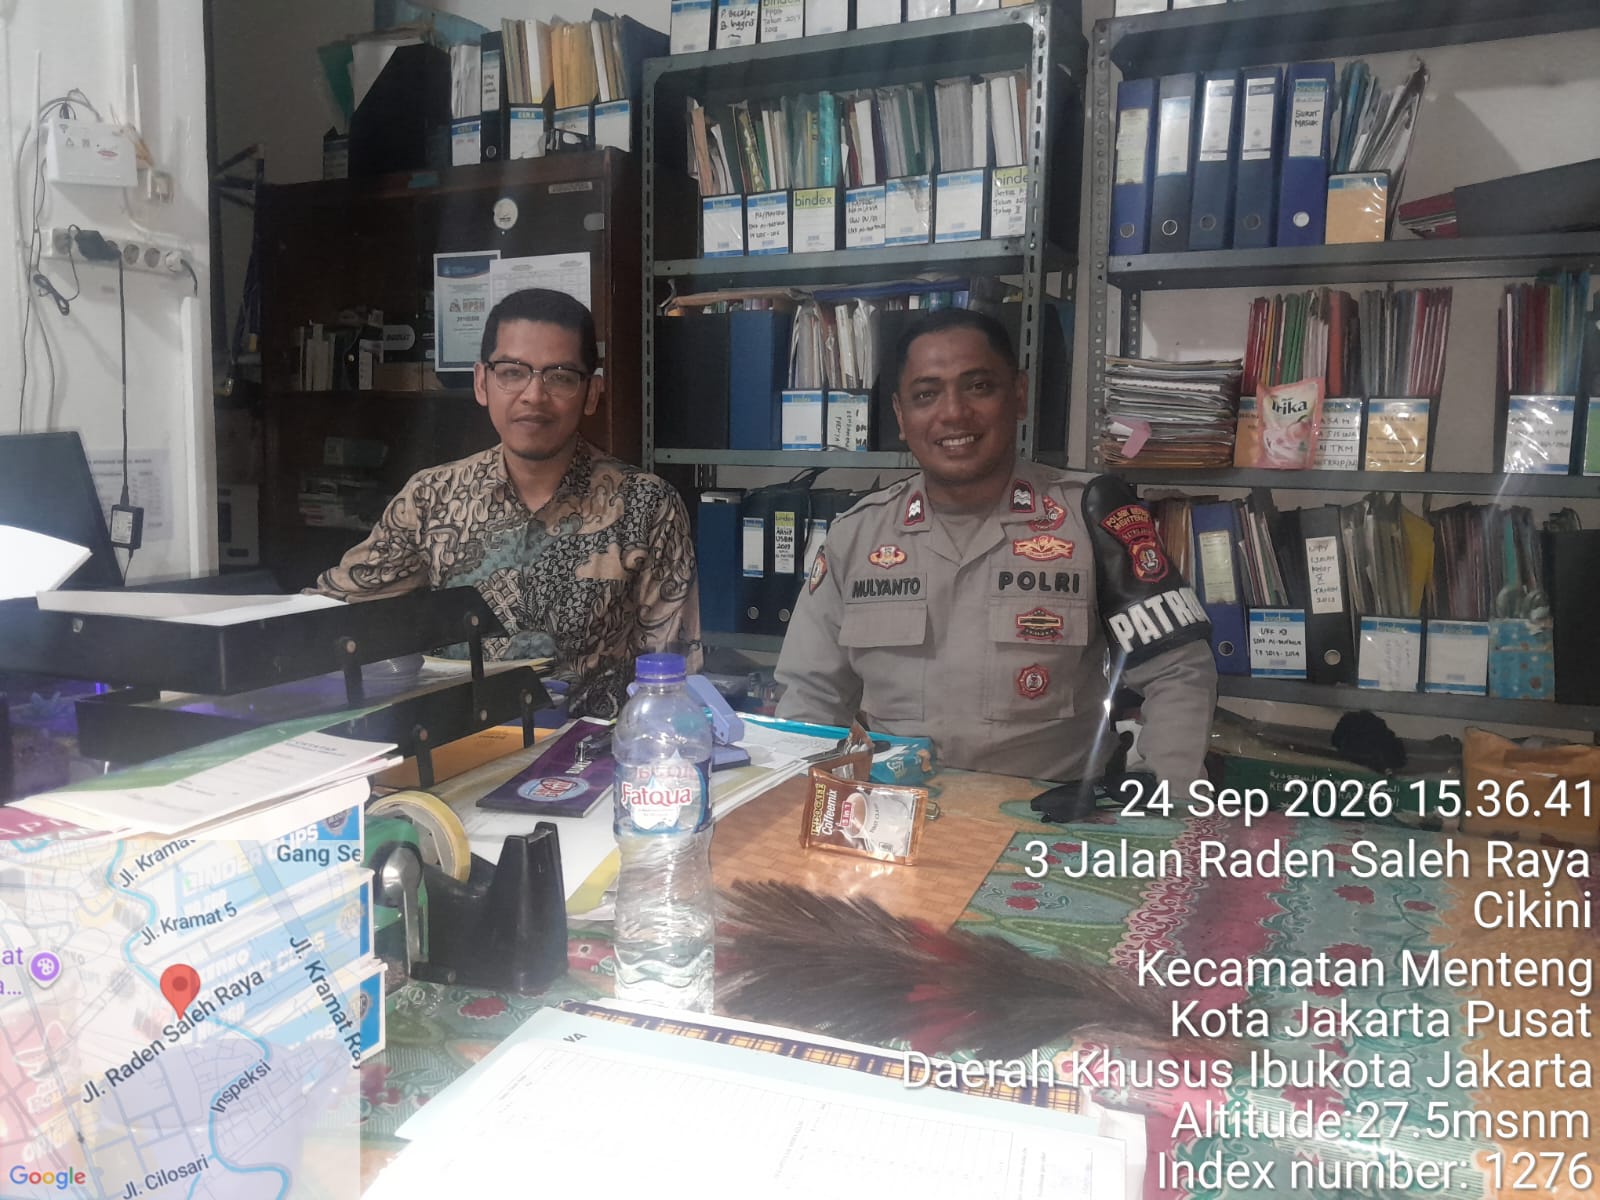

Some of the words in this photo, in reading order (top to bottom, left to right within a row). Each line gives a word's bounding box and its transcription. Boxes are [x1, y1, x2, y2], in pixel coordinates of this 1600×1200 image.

[993, 168, 1028, 187] binde
[795, 190, 833, 207] bindex
[852, 577, 921, 599] MULYANTO
[998, 570, 1080, 594] POLRI
[822, 788, 838, 836] Coffeemix
